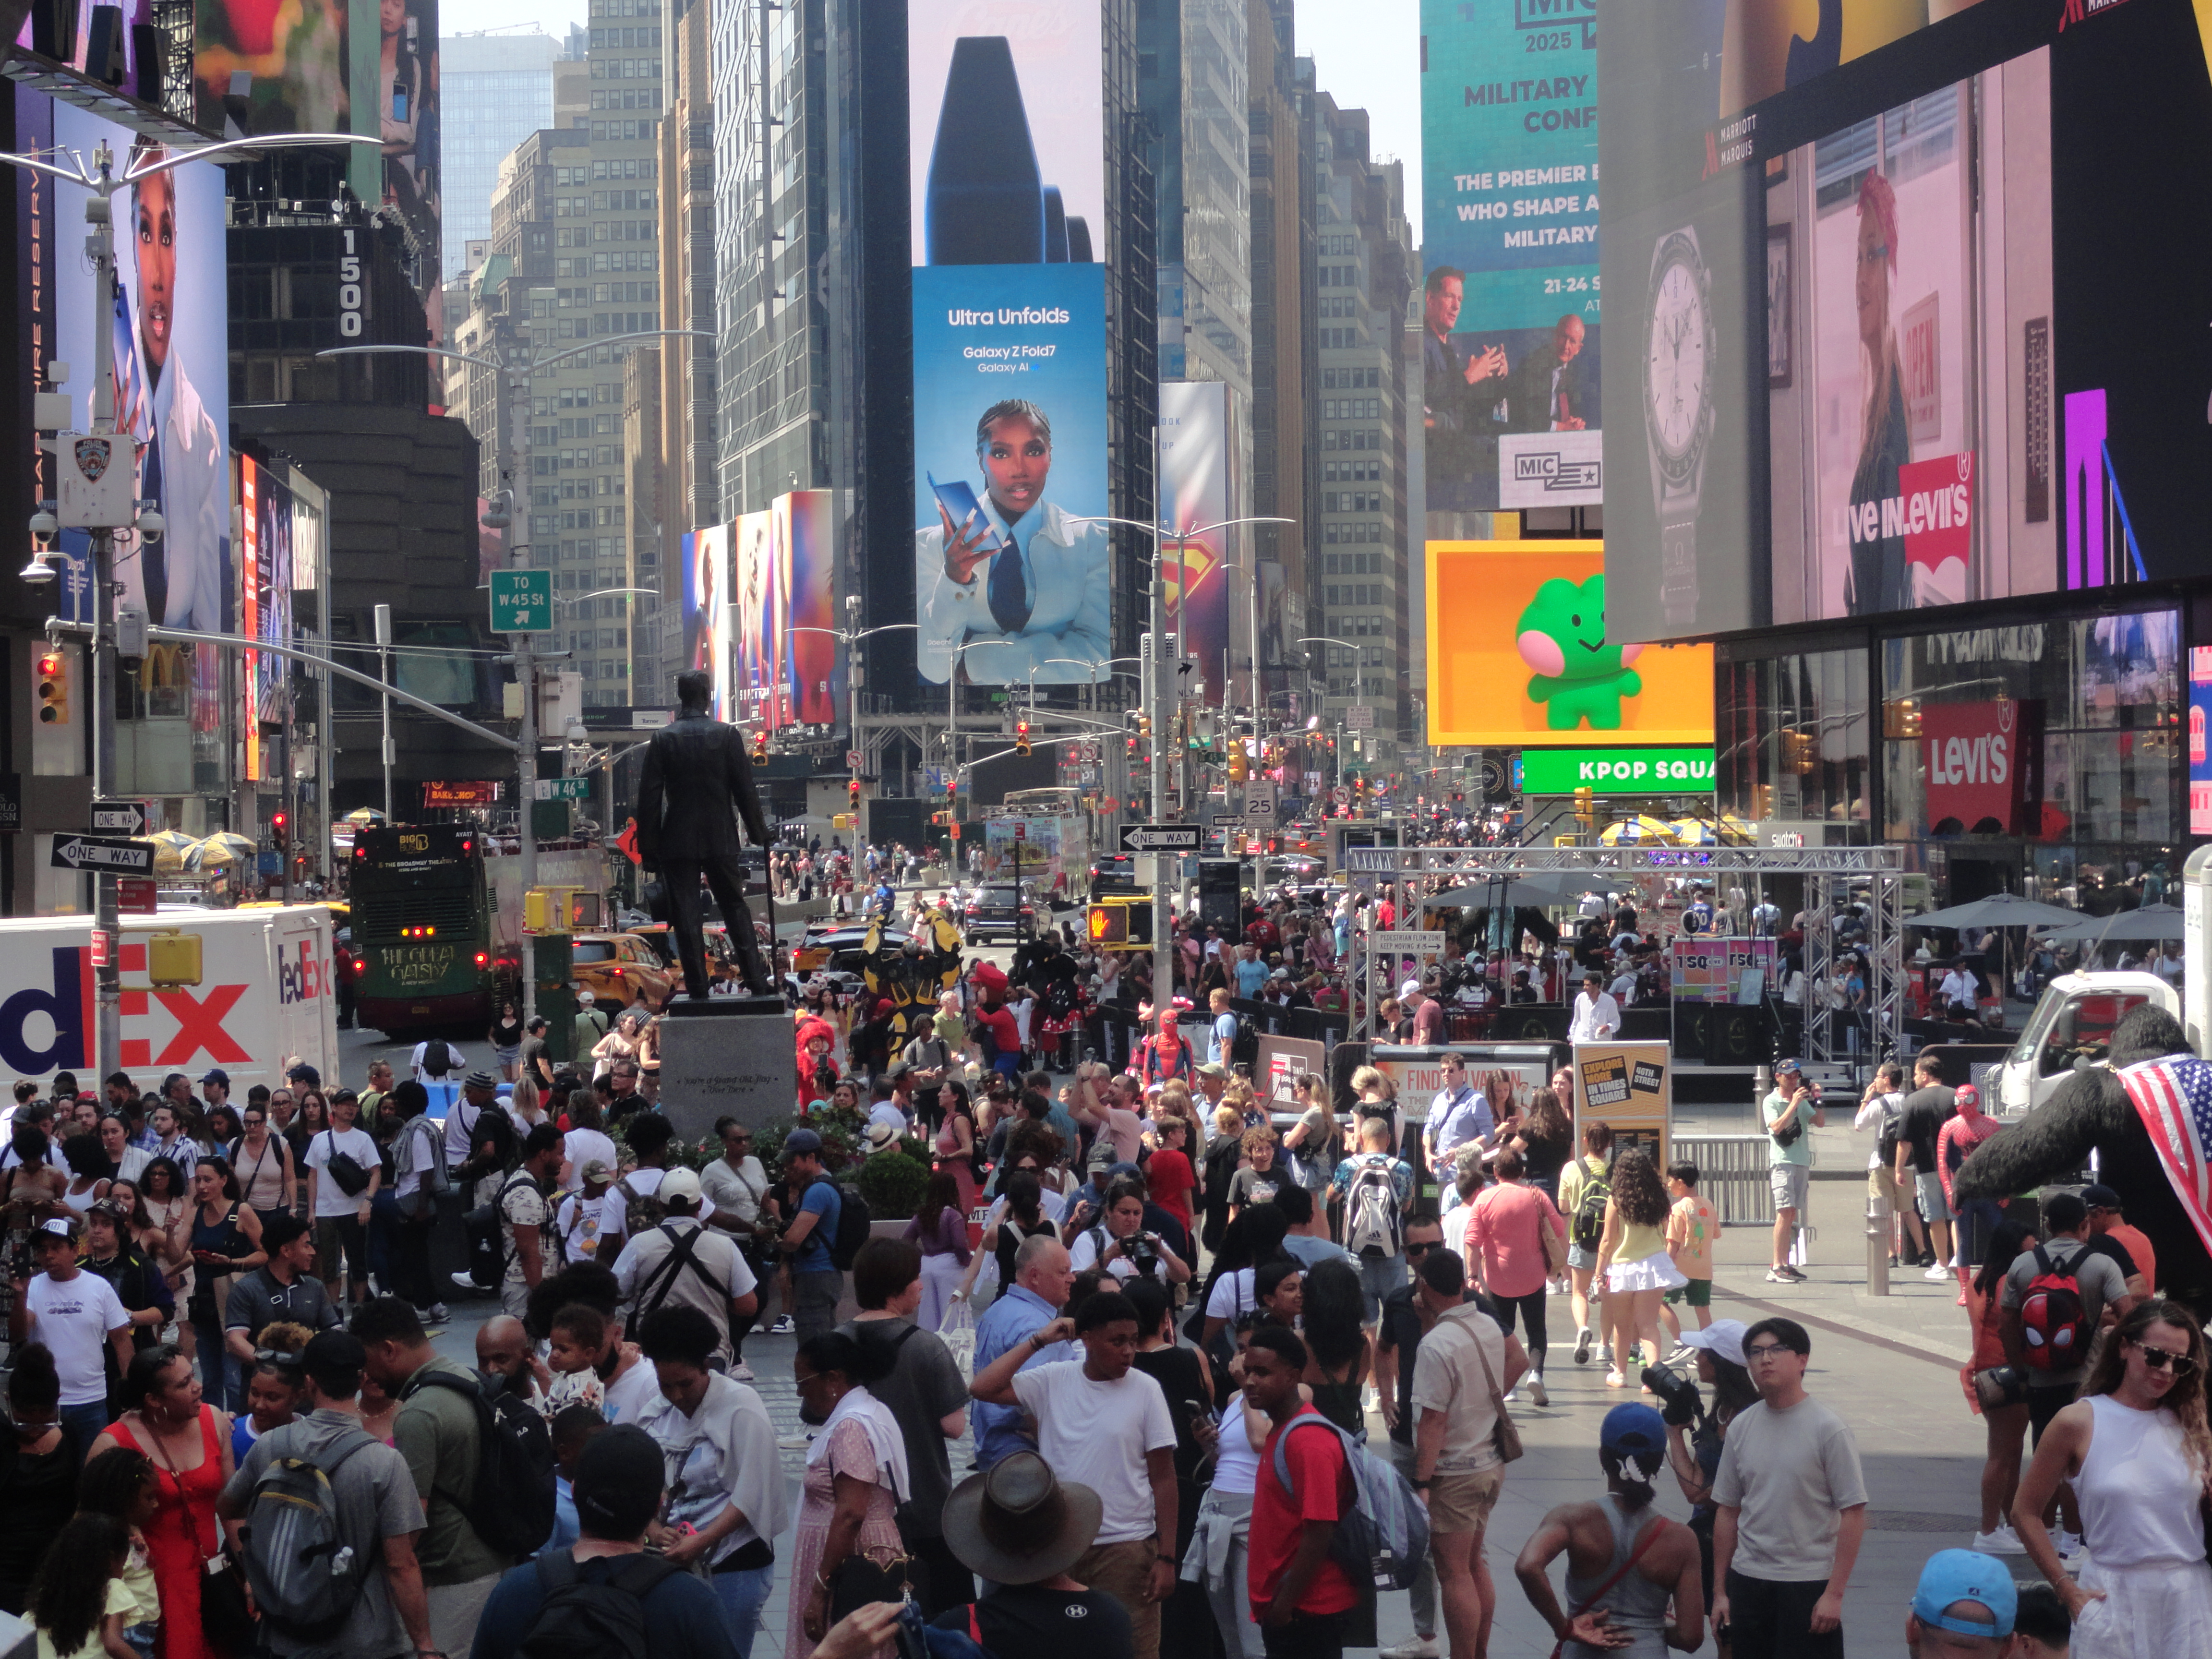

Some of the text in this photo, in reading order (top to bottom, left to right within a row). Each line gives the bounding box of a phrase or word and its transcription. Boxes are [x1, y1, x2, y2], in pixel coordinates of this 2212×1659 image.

[1525, 32, 1572, 53] 2025
[1464, 75, 1588, 107] MILITARY
[1721, 113, 1757, 144] MARRIOTT
[1721, 140, 1753, 166] MARQUIS
[1454, 173, 1492, 192] THE
[1498, 165, 1586, 188] PREMIER
[1457, 202, 1508, 221] WHO
[1513, 196, 1579, 217] SHAPE
[1504, 225, 1598, 248] MILITARY
[340, 230, 361, 337] 1500
[1544, 277, 1588, 294] 21-24
[949, 307, 1070, 325] Ultra Unfolds
[963, 345, 1056, 360] Galaxy Z Fold7
[978, 363, 1028, 374] Galaxy AI
[1520, 458, 1555, 475] MIC
[513, 577, 529, 589] TO
[499, 593, 544, 606] W 45 St
[1579, 761, 1648, 780] KPOP
[552, 780, 585, 796] W 46 St
[1249, 800, 1271, 813] 25
[98, 813, 137, 826] ONE WAY
[399, 834, 416, 844] BIG
[1132, 832, 1190, 844] ONE WAY
[1771, 831, 1797, 847] swatch
[67, 845, 141, 864] ONE WAY
[399, 843, 416, 852] BUS
[391, 962, 449, 979] GATSBY
[1676, 955, 1707, 970] TSQ
[1584, 1058, 1624, 1074] EXPLORE
[1407, 1070, 1440, 1090] FIND
[1585, 1070, 1612, 1084] MORE
[1634, 1075, 1660, 1087] STREET
[1587, 1078, 1626, 1095] IN TIMES
[1407, 1096, 1430, 1105] THE
[1589, 1089, 1627, 1106] SQUARE
